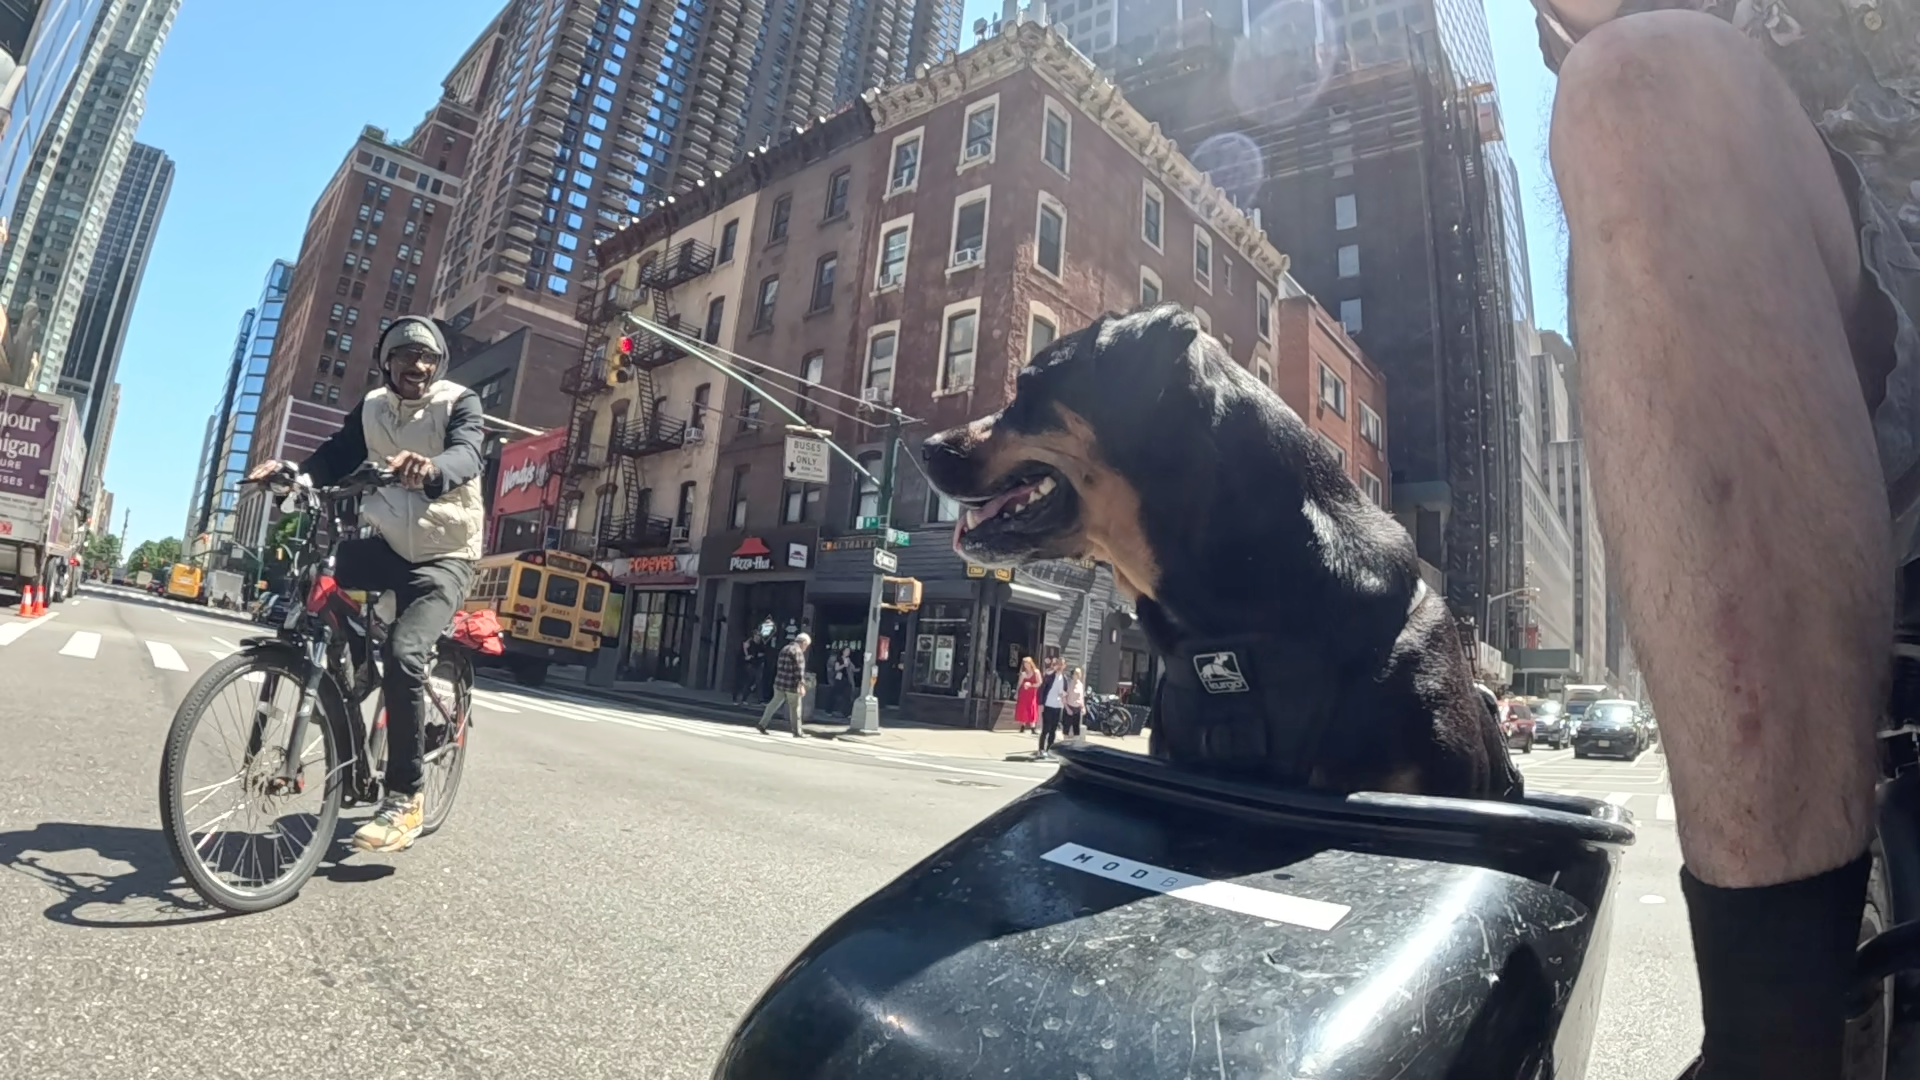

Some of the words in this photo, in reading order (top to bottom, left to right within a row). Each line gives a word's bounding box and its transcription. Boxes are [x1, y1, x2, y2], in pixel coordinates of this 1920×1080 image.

[0, 431, 40, 459] igan
[793, 440, 822, 452] BUSES
[795, 454, 818, 466] ONLY
[0, 474, 23, 487] SES
[501, 456, 535, 497] Wendy's
[729, 556, 752, 571] Pizza
[752, 556, 770, 570] Hut
